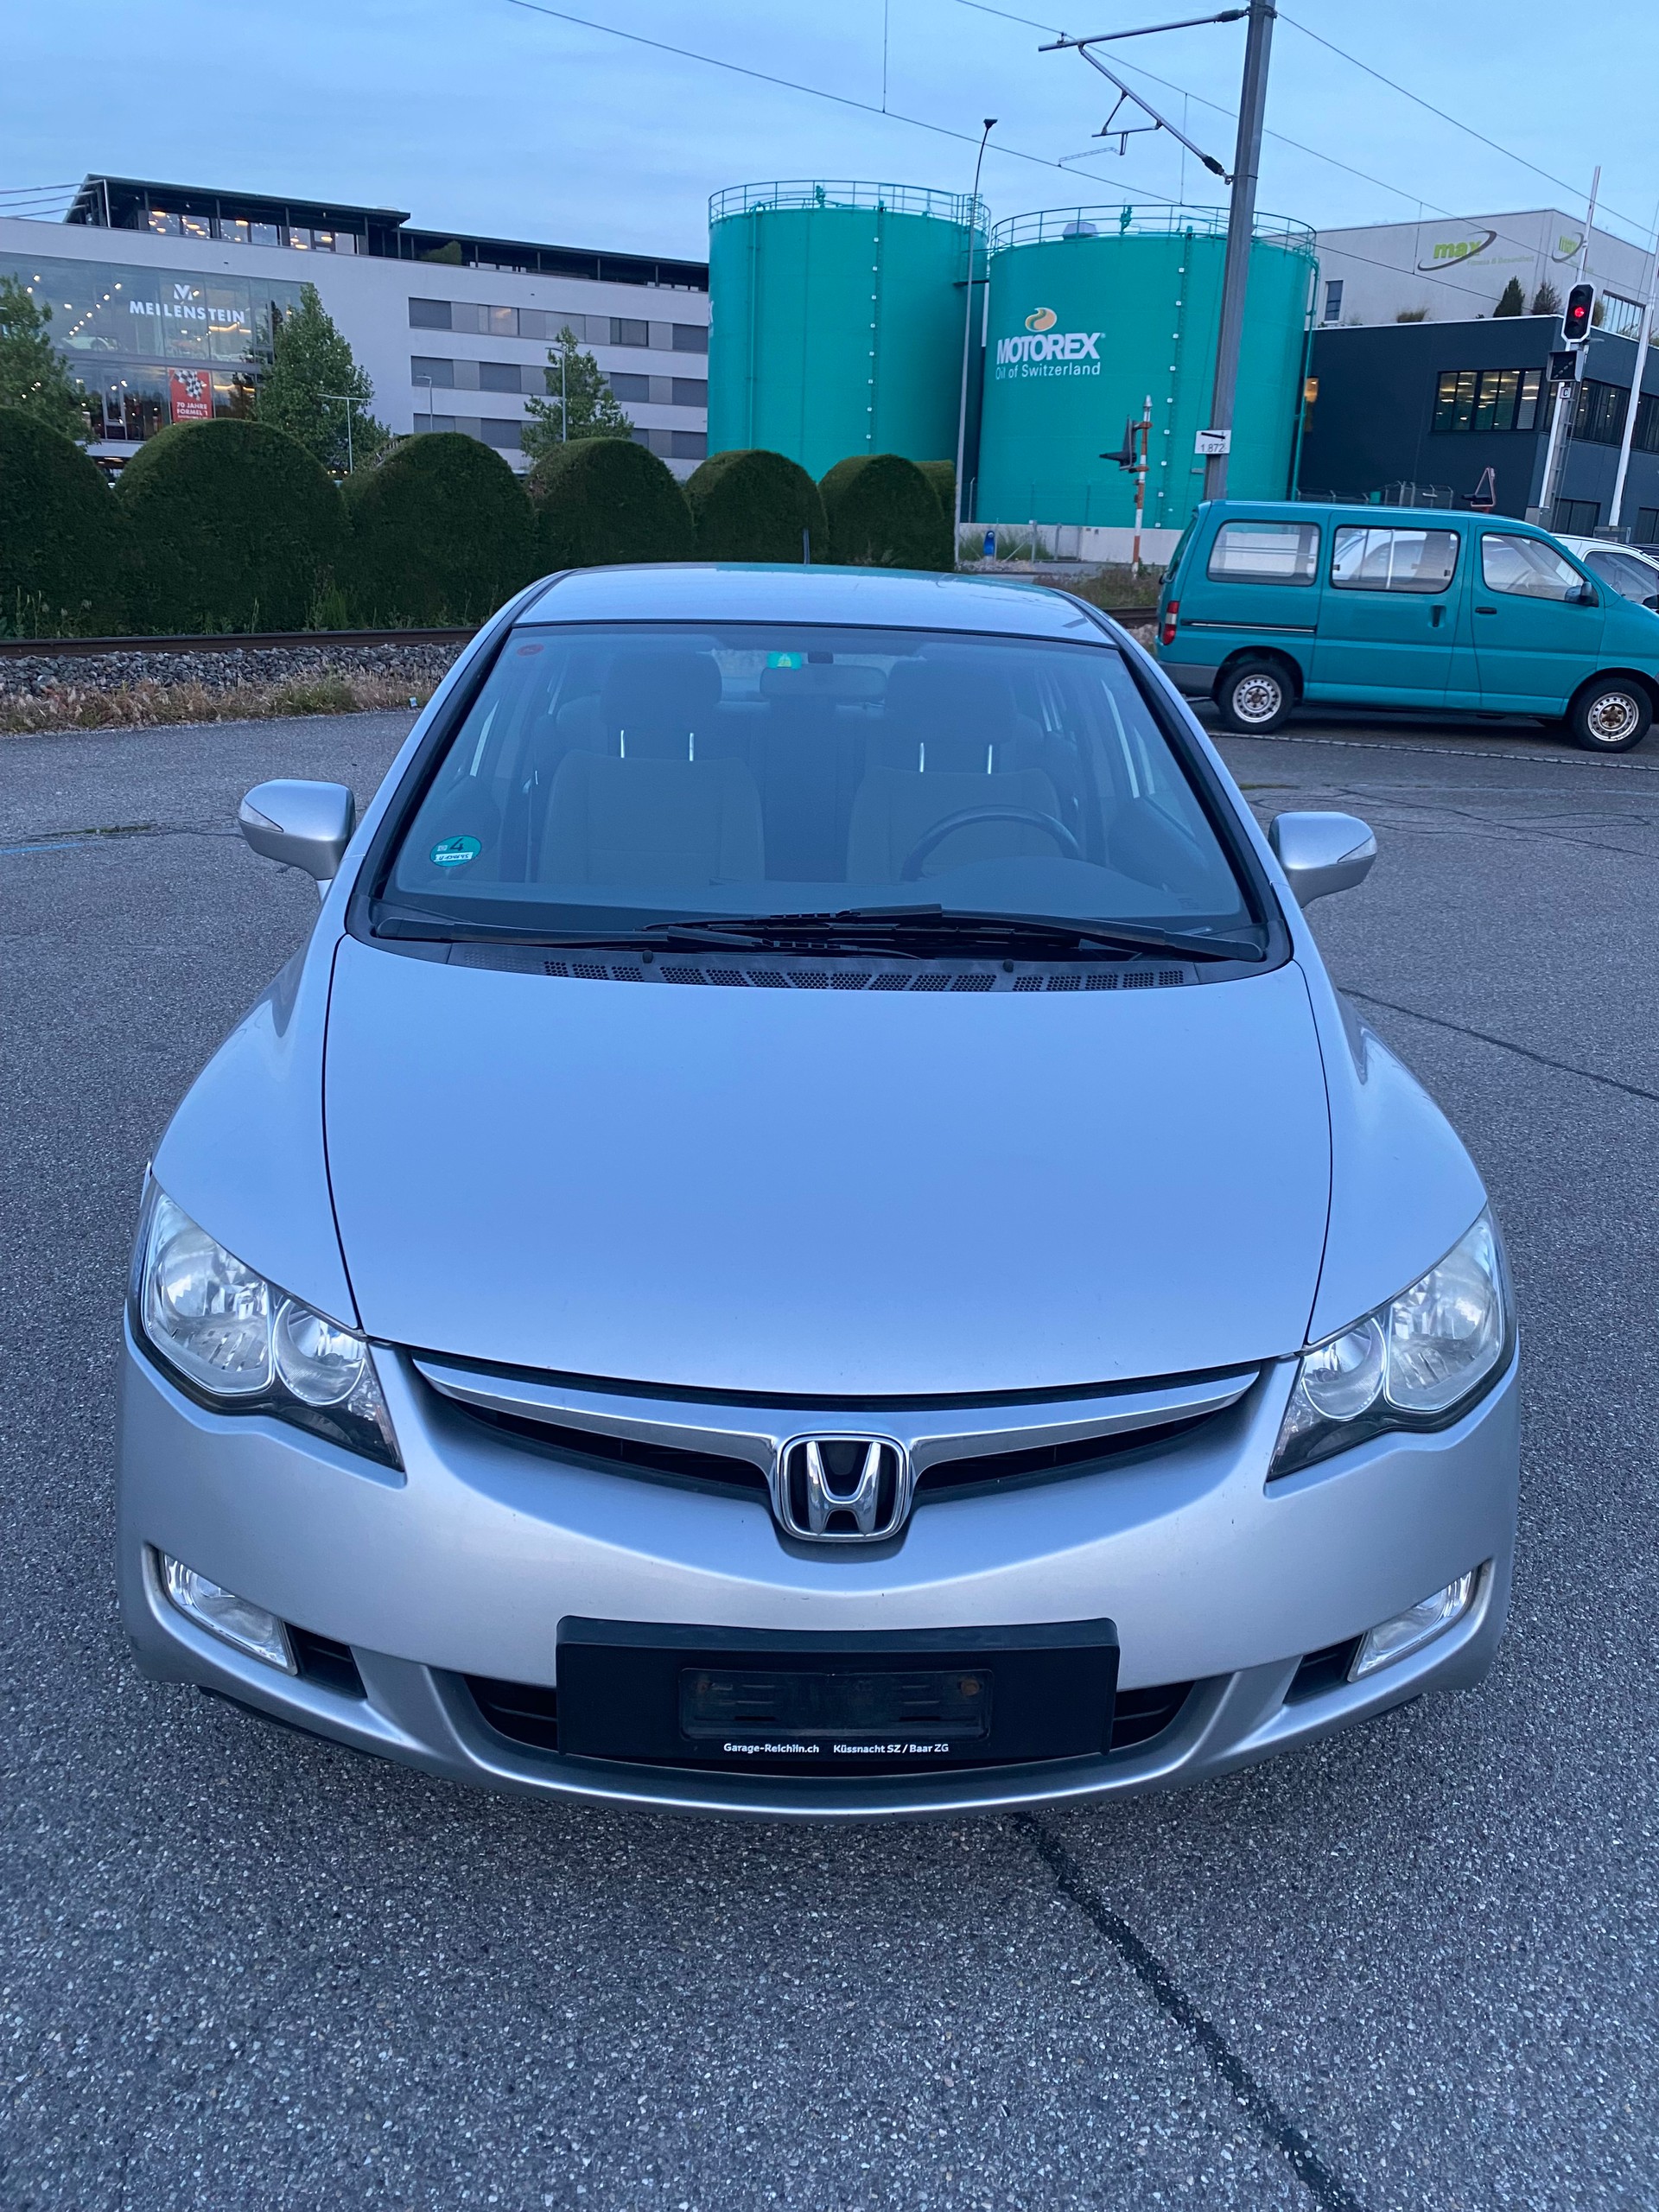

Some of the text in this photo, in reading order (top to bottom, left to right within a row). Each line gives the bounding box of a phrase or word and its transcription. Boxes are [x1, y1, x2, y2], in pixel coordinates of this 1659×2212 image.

[129, 300, 245, 324] MEILENSTEIN
[996, 332, 1101, 365] MOTOREX
[995, 361, 1101, 380] Oil of Switzerland
[176, 408, 202, 416] FORMEL
[449, 837, 464, 851] 4
[723, 1743, 950, 1754] Garage-Reichlin.ch Küssnacht SZ / Baar ZG
